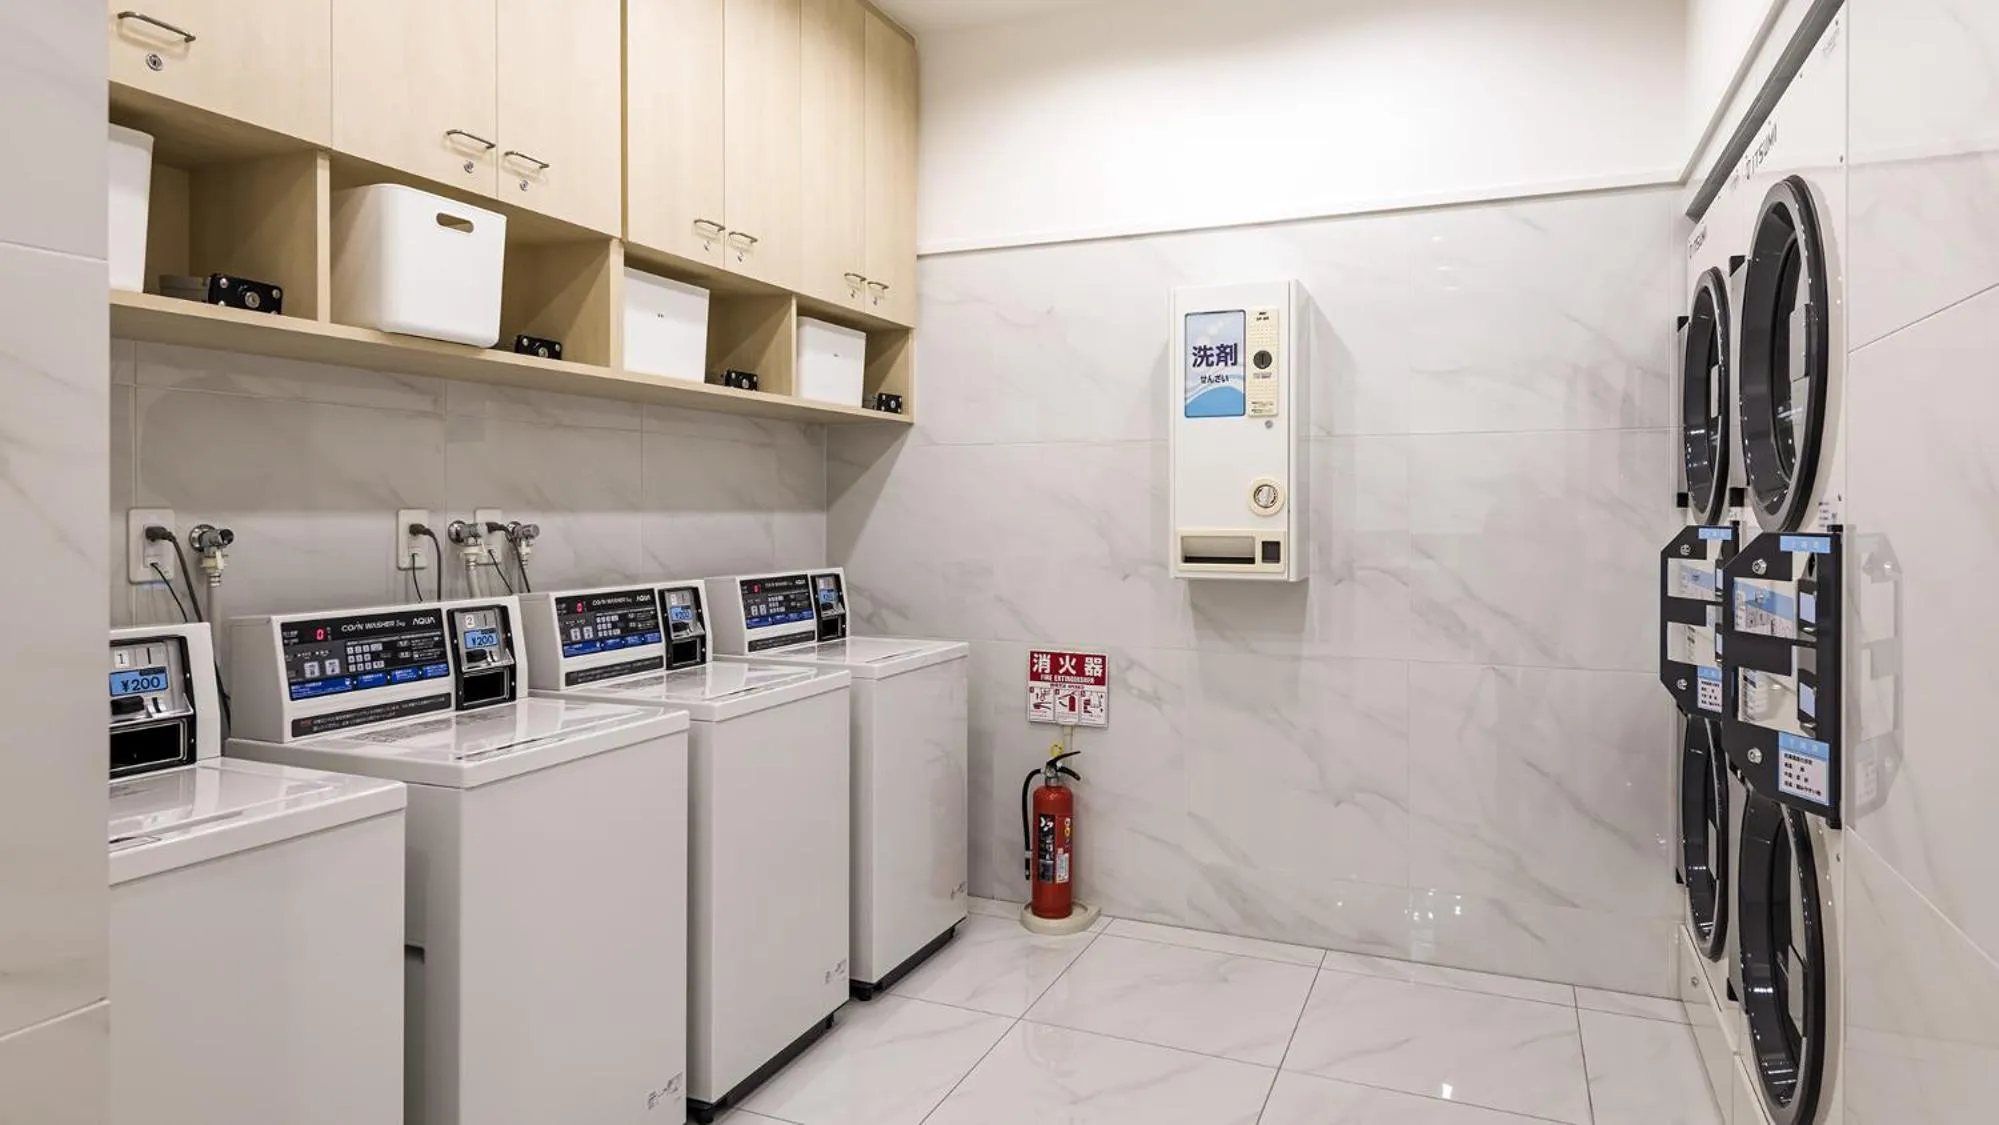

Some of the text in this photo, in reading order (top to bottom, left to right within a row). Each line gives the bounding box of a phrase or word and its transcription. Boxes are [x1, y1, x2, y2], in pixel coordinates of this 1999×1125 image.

[1192, 343, 1238, 368] 洗剤
[1200, 374, 1229, 384] せんざい
[365, 620, 395, 630] WASHER
[412, 616, 436, 626] AQUA
[466, 616, 473, 626] 2
[316, 628, 325, 641] 0
[471, 635, 494, 646] ¥200
[117, 653, 124, 665] 1
[1032, 653, 1103, 677] 消火器
[121, 676, 161, 692] ¥200
